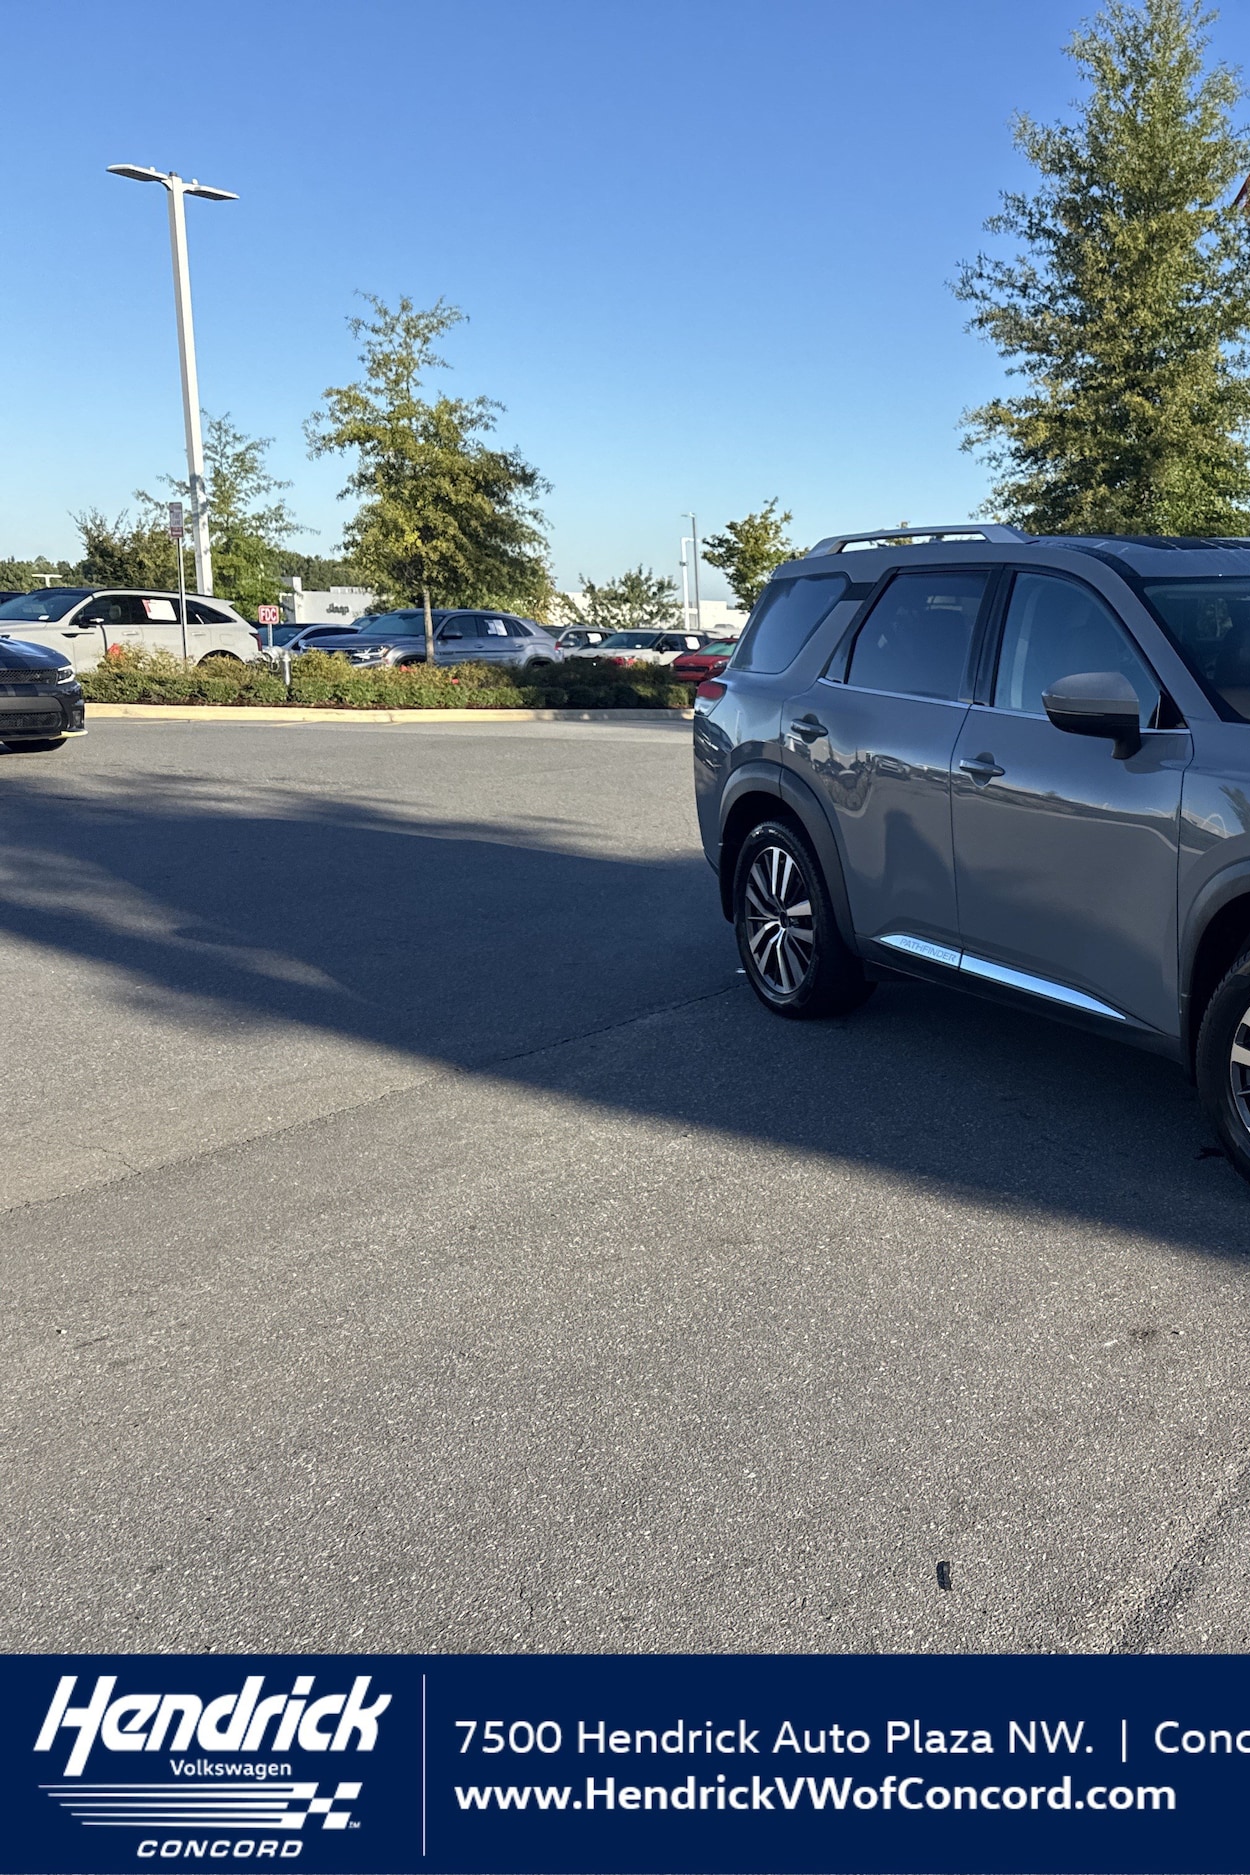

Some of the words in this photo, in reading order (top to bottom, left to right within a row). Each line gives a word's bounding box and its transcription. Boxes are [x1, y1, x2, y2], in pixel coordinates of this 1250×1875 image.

[260, 608, 277, 621] FDC
[326, 603, 349, 616] Jeep
[900, 938, 957, 962] PATHFINDER
